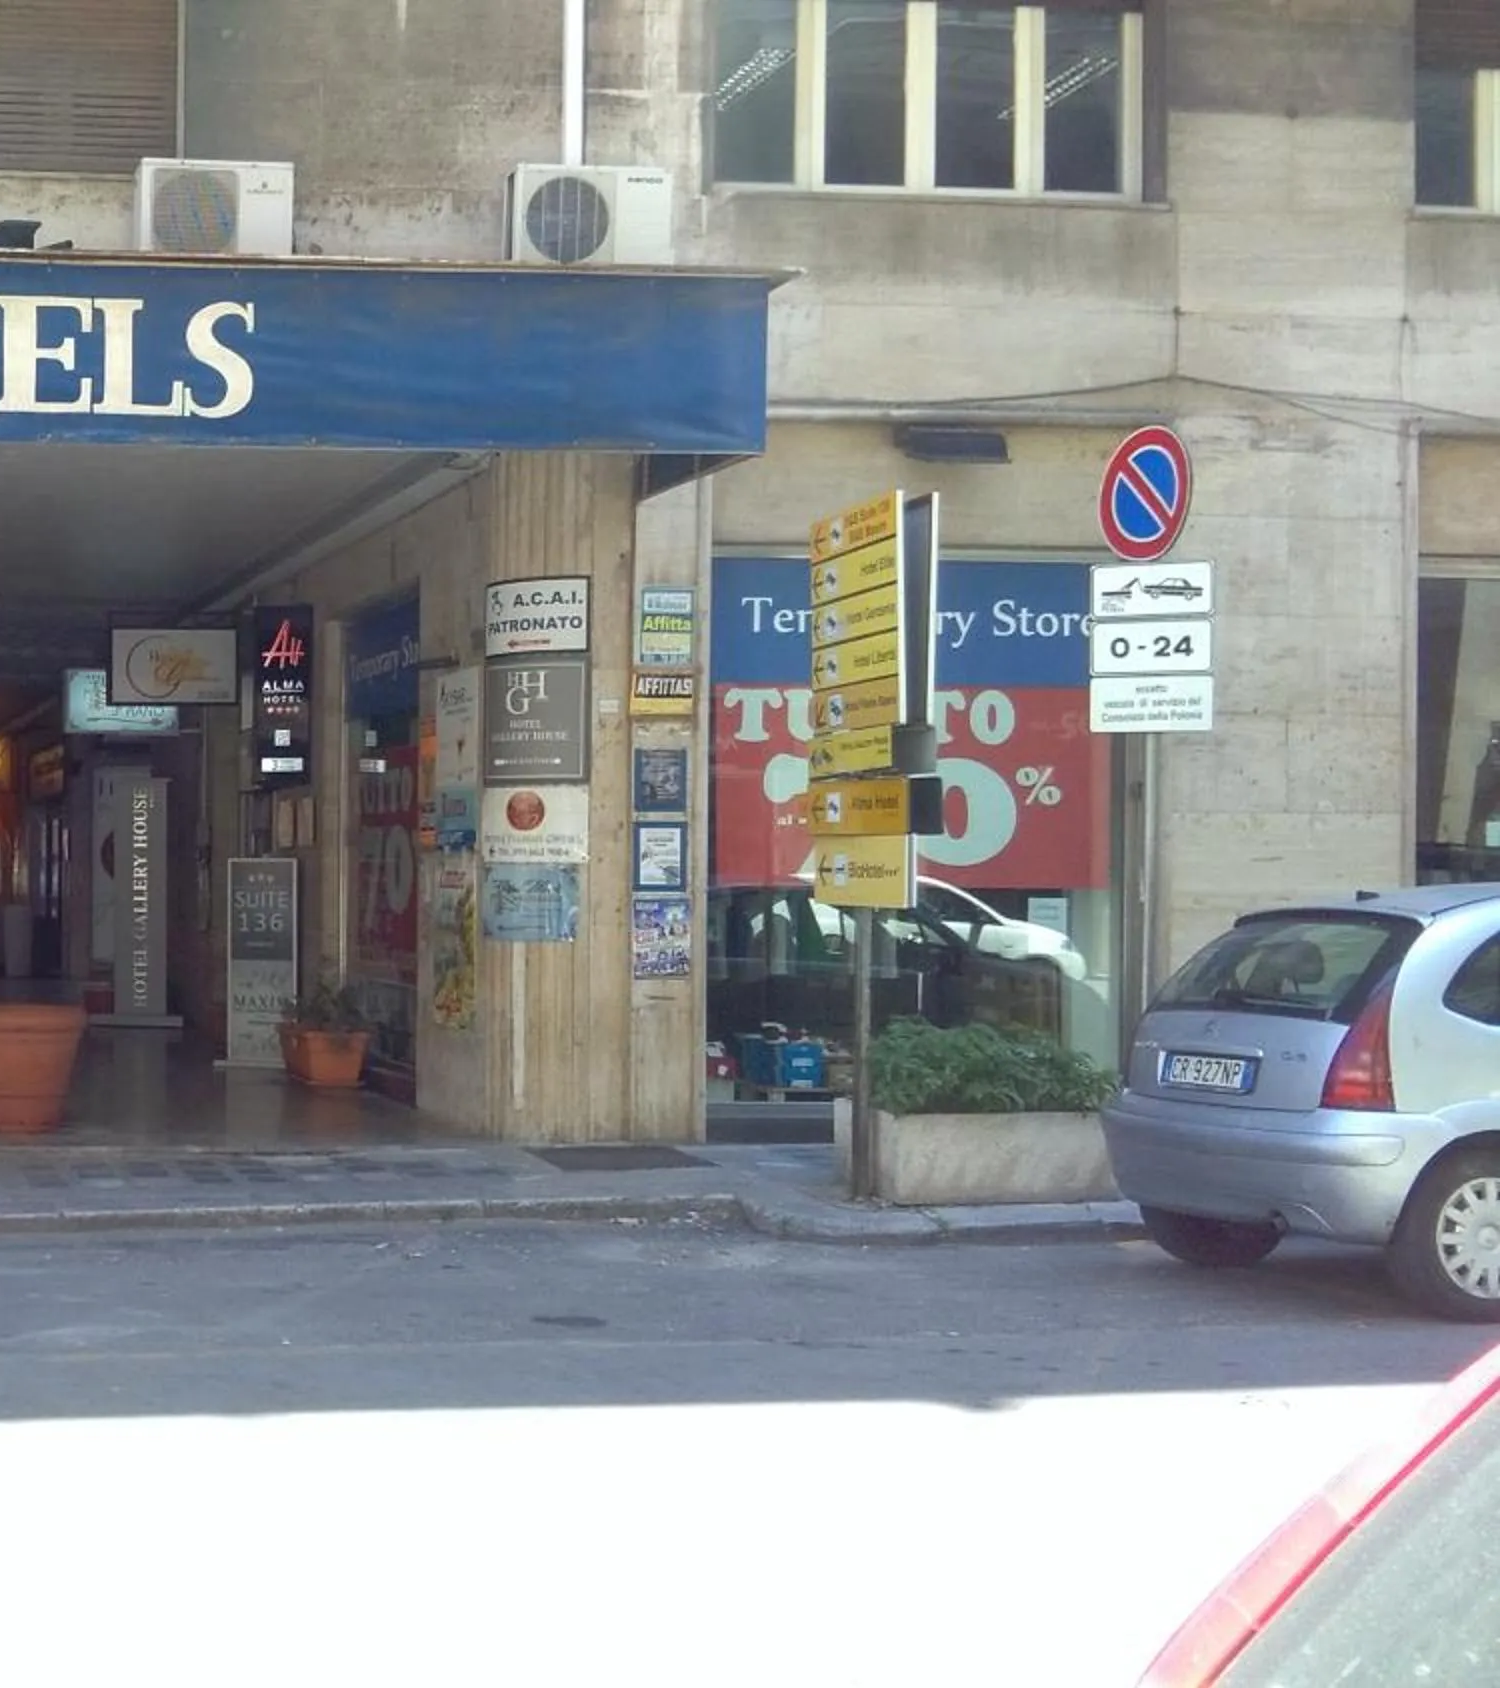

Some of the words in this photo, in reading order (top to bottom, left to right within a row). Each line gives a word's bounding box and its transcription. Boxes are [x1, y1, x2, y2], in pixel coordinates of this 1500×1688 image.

[513, 590, 584, 608] A.C.A.I.
[487, 615, 583, 636] PATRONATO
[643, 615, 691, 631] Affitta
[1153, 635, 1194, 657] 24
[261, 679, 305, 690] ALMA
[262, 695, 303, 704] HOTEL
[724, 688, 1016, 746] TUTO
[132, 788, 149, 849] HOUSE
[132, 856, 148, 943] GALLERY
[234, 890, 290, 908] SUITE
[239, 912, 284, 932] 136
[132, 949, 148, 1009] HOTEL
